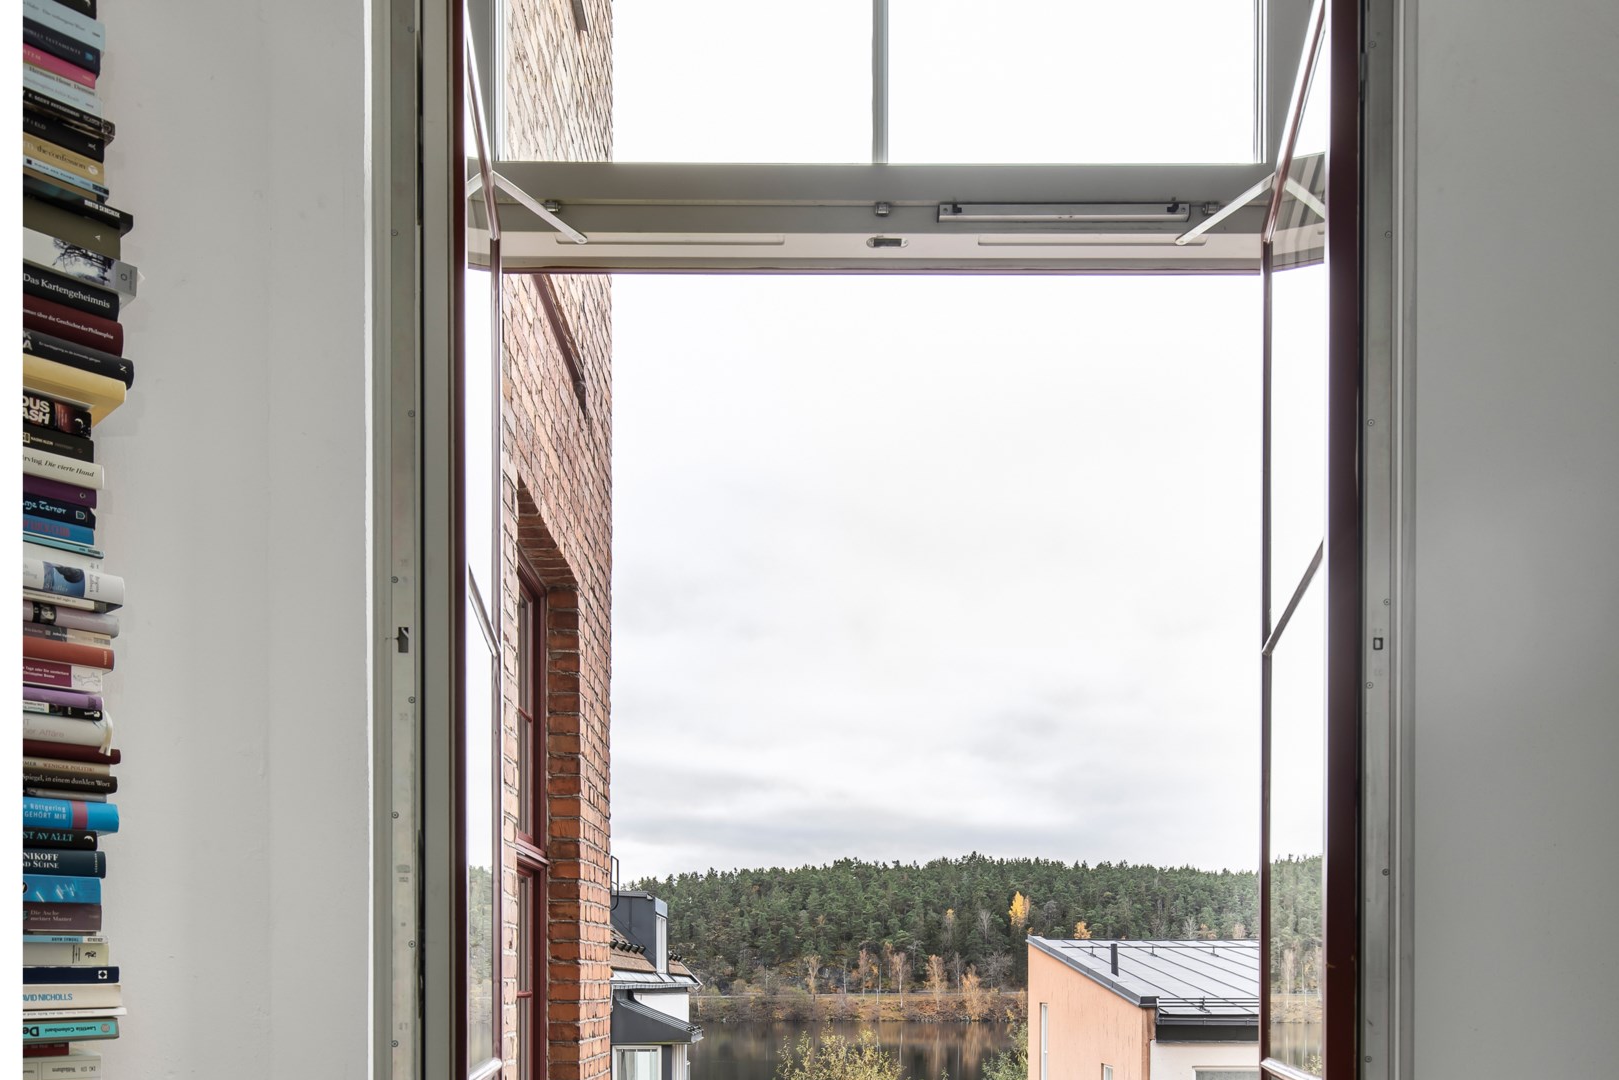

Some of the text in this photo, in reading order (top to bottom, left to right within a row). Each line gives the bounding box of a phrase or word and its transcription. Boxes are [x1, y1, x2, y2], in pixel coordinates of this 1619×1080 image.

[23, 273, 110, 308] Das Kartengeheimnis
[45, 460, 57, 469] Die
[76, 468, 95, 478] Hand
[38, 500, 67, 514] Terror
[43, 762, 69, 770] WENIGER
[52, 776, 70, 784] einem
[95, 779, 111, 788] Wort
[36, 832, 49, 841] AV
[51, 833, 74, 842] ALLT
[33, 860, 60, 869] SÜHNE
[38, 992, 73, 1001] NICHOLLS
